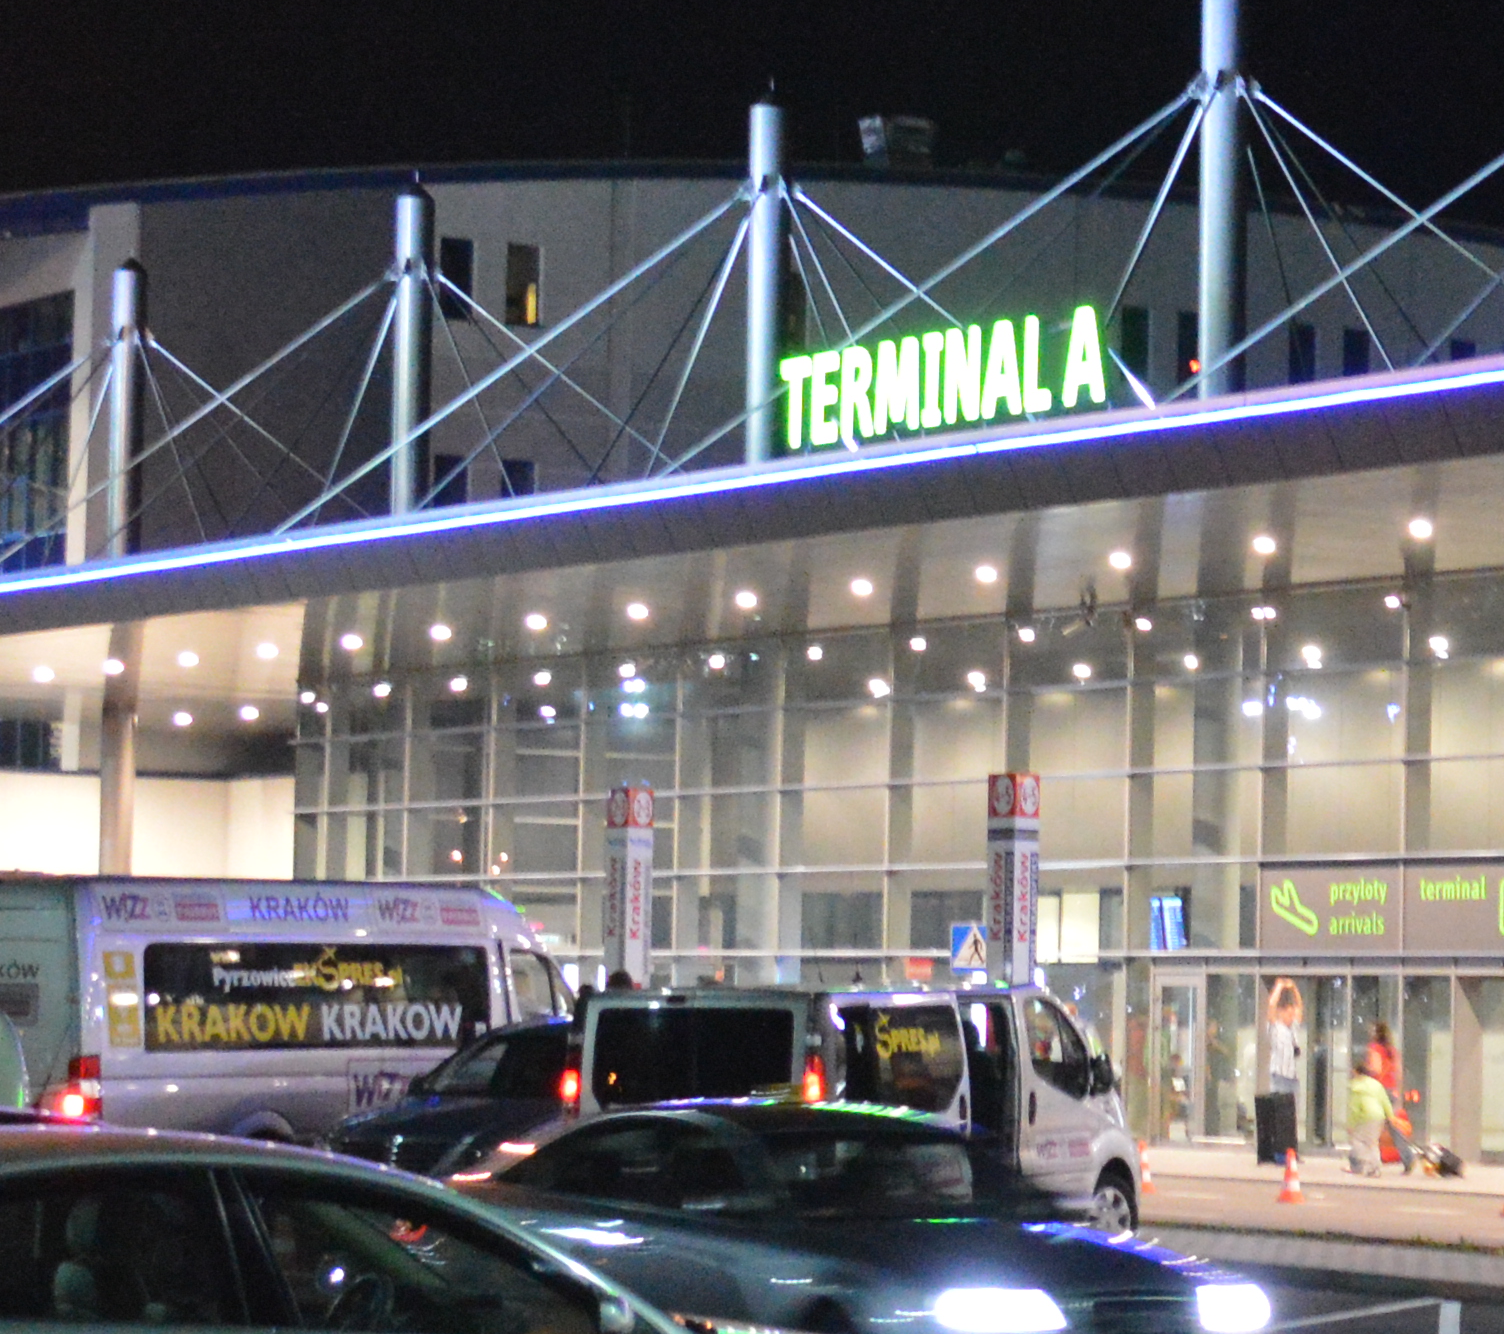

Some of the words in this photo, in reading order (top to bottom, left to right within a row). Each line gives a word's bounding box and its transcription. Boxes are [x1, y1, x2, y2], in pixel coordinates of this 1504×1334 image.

[780, 315, 1052, 450] TERMINAL
[1061, 304, 1106, 409] A
[1329, 877, 1388, 906] przyloty
[1419, 875, 1487, 901] terminal
[249, 892, 349, 922] KRAKÓW
[1329, 911, 1385, 935] arrivals
[156, 1003, 311, 1043] KRAKOW
[321, 1002, 463, 1040] KRAKOW
